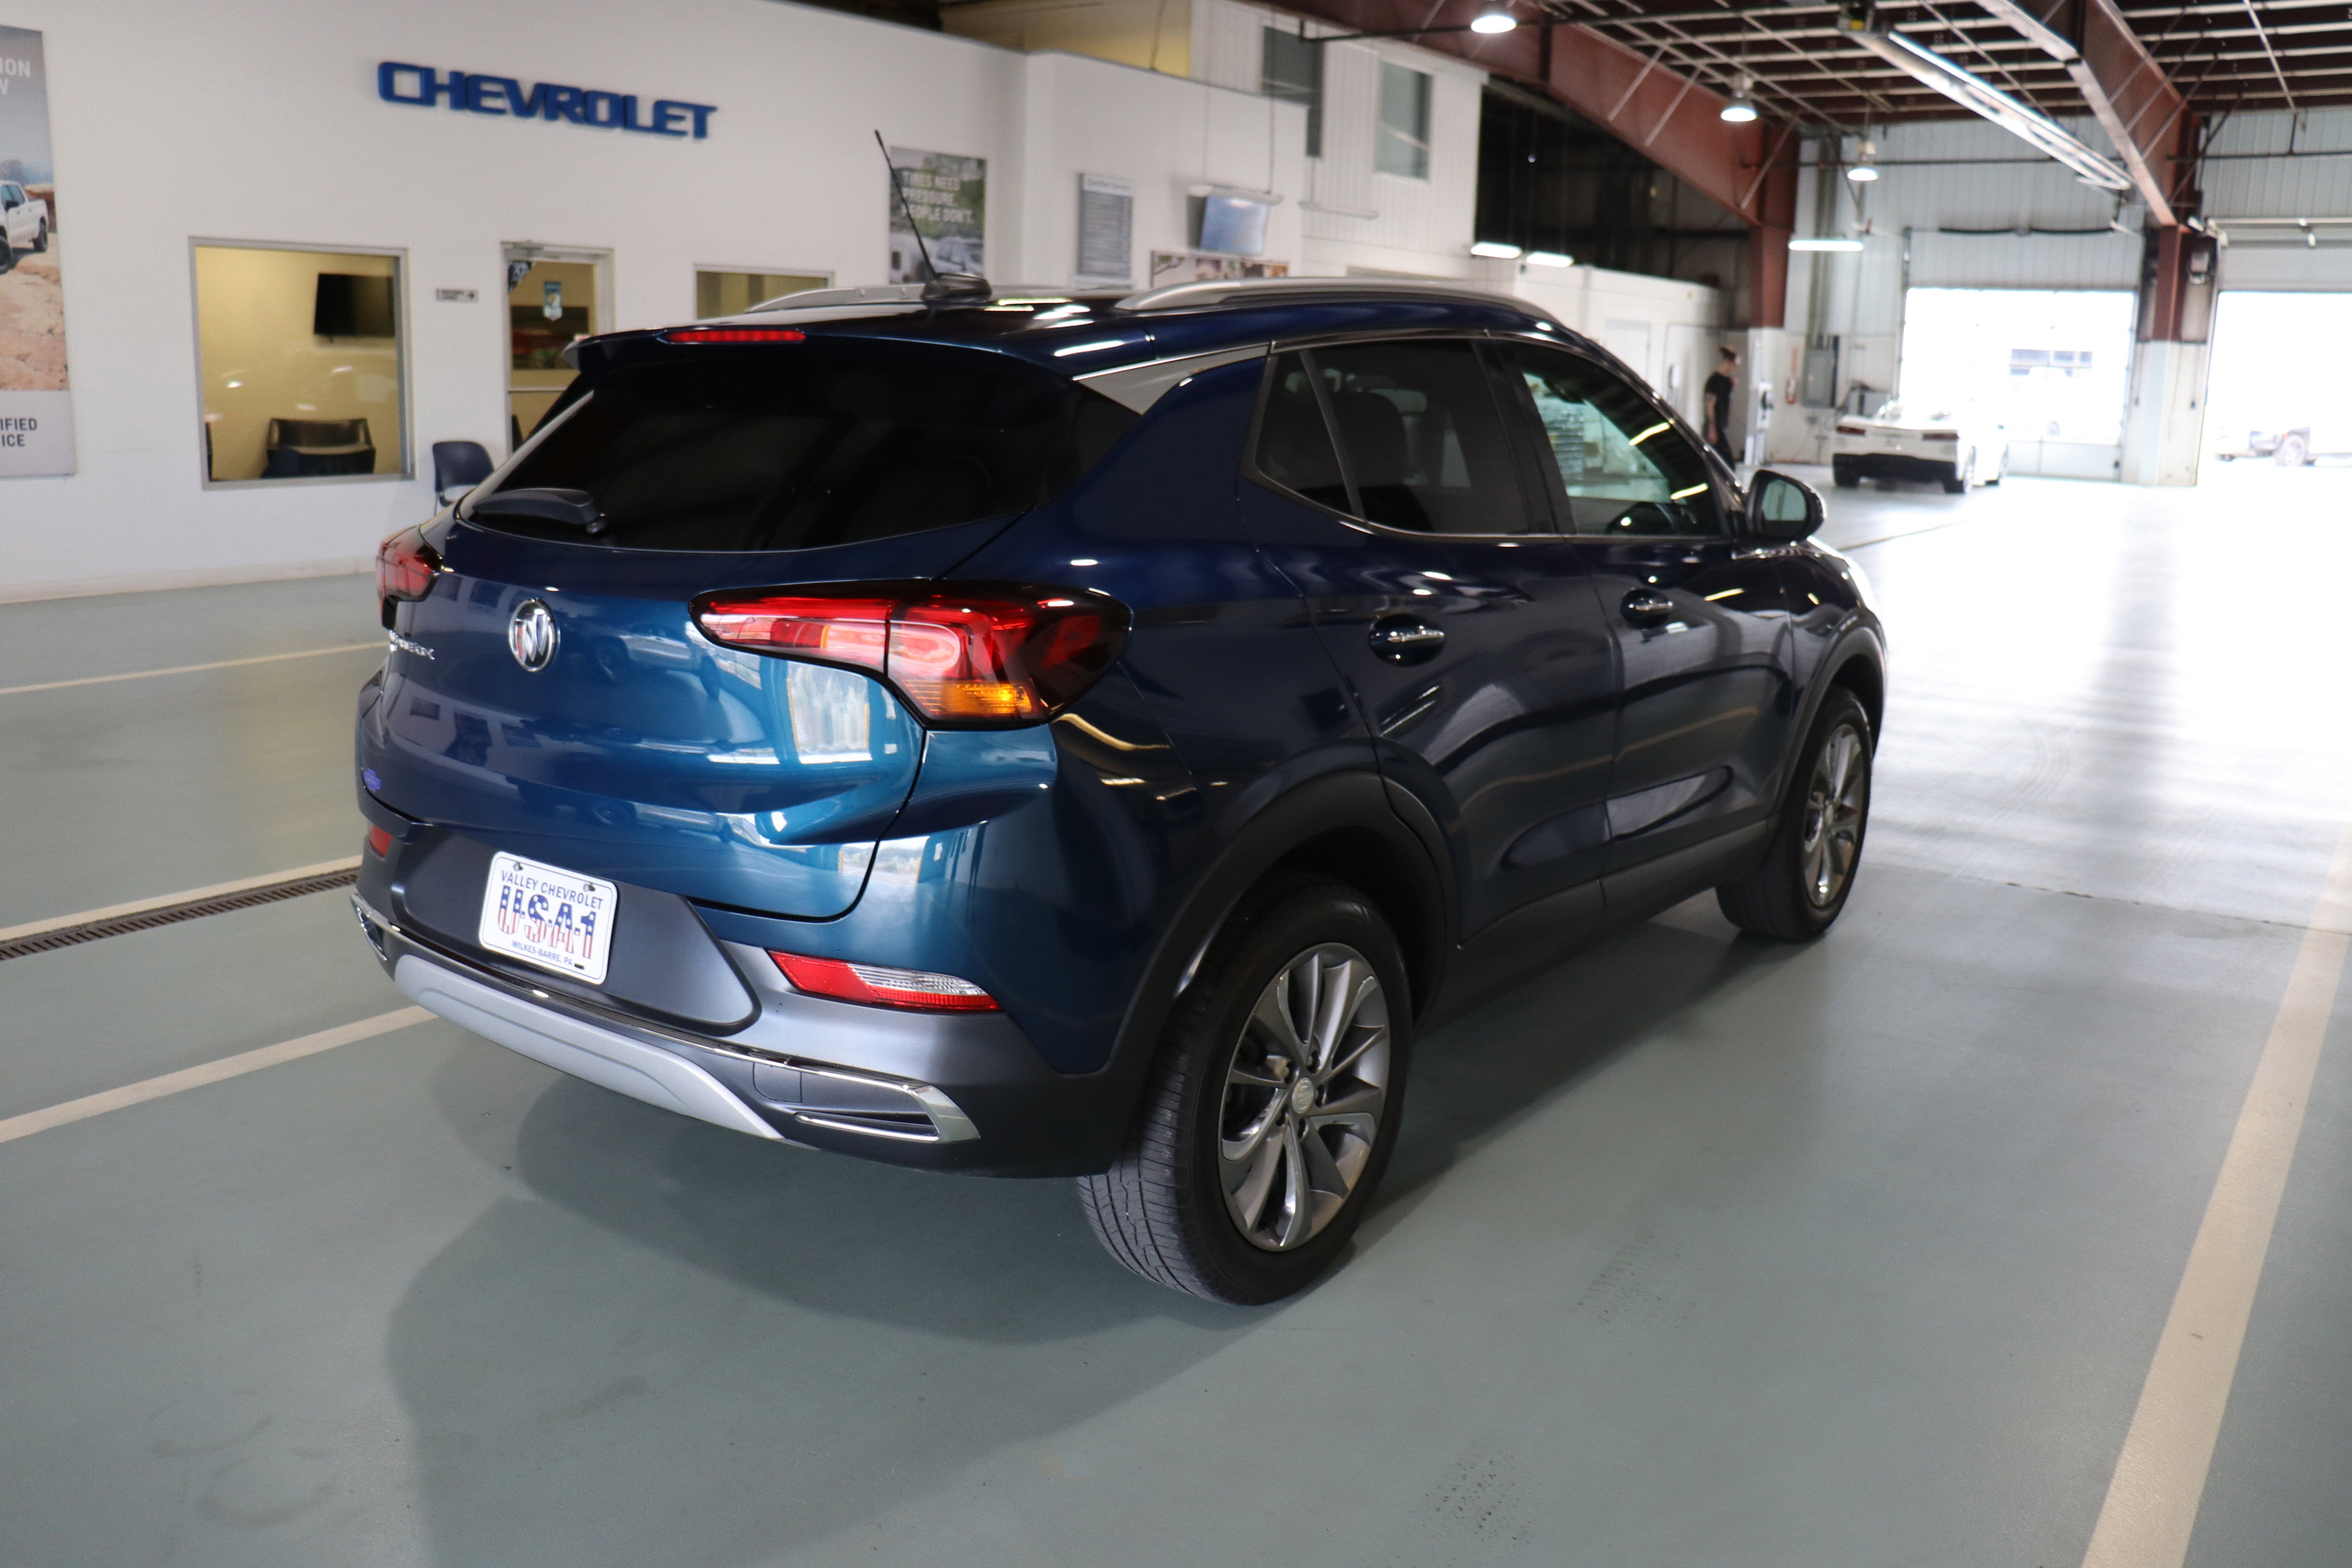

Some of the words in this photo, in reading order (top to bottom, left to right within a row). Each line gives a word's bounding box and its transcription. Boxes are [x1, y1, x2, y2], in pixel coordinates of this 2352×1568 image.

[378, 61, 717, 139] CHEVROLET
[2, 434, 25, 447] ICE
[502, 870, 538, 890] VALLEY
[541, 882, 603, 910] CHEVROLET
[564, 956, 572, 966] PA
